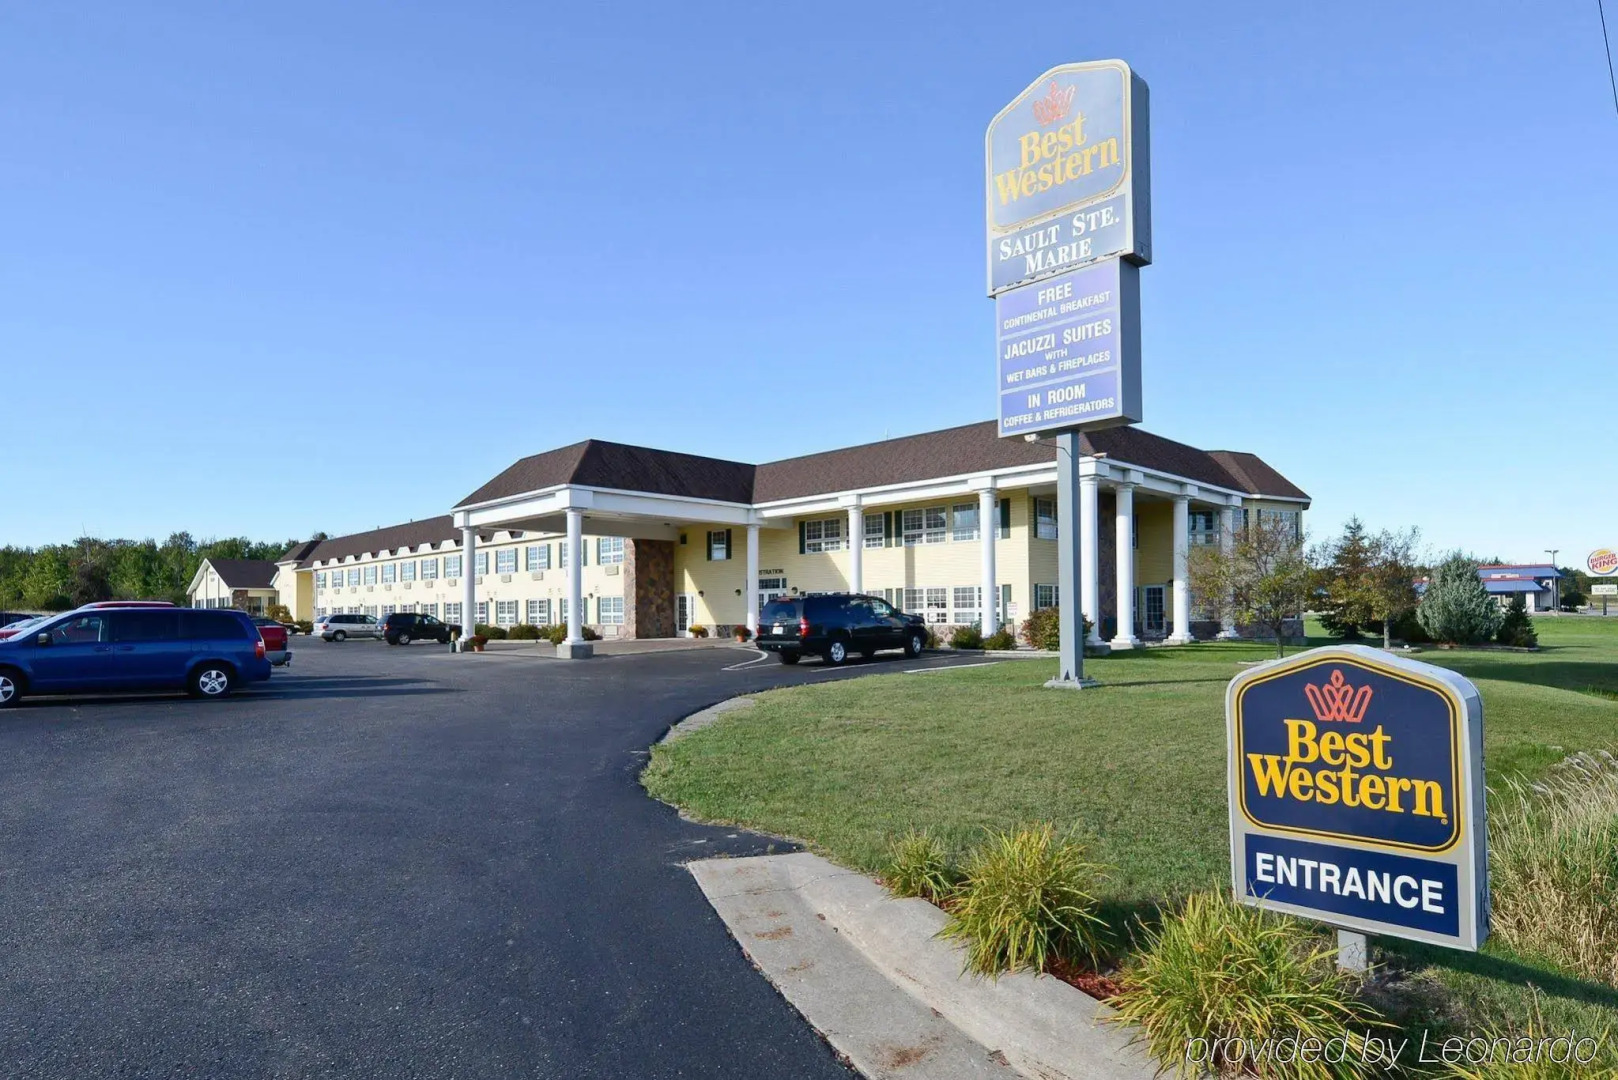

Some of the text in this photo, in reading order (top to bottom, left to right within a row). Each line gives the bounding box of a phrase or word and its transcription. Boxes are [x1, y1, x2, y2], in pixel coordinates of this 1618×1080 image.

[1018, 111, 1087, 171] Best
[996, 136, 1120, 205] Western
[1000, 205, 1120, 261] SAULT STE.
[1025, 237, 1092, 276] MARIE
[1004, 291, 1111, 330] CONTINENTAL BREAKFAST
[1038, 282, 1072, 306] FREE
[1004, 318, 1112, 360] JACUZZI SUITES
[1045, 348, 1068, 361] WITH
[1006, 350, 1110, 384] WET BARS & FIREPLACES
[1004, 397, 1114, 428] COFFEE & REFRIGERATORS
[1028, 384, 1086, 408] IN ROOM
[1590, 552, 1616, 564] BURGER
[1592, 558, 1617, 570] KING
[1284, 719, 1392, 770] Best
[1247, 753, 1447, 818] Western
[1256, 852, 1444, 914] ENTRANCE
